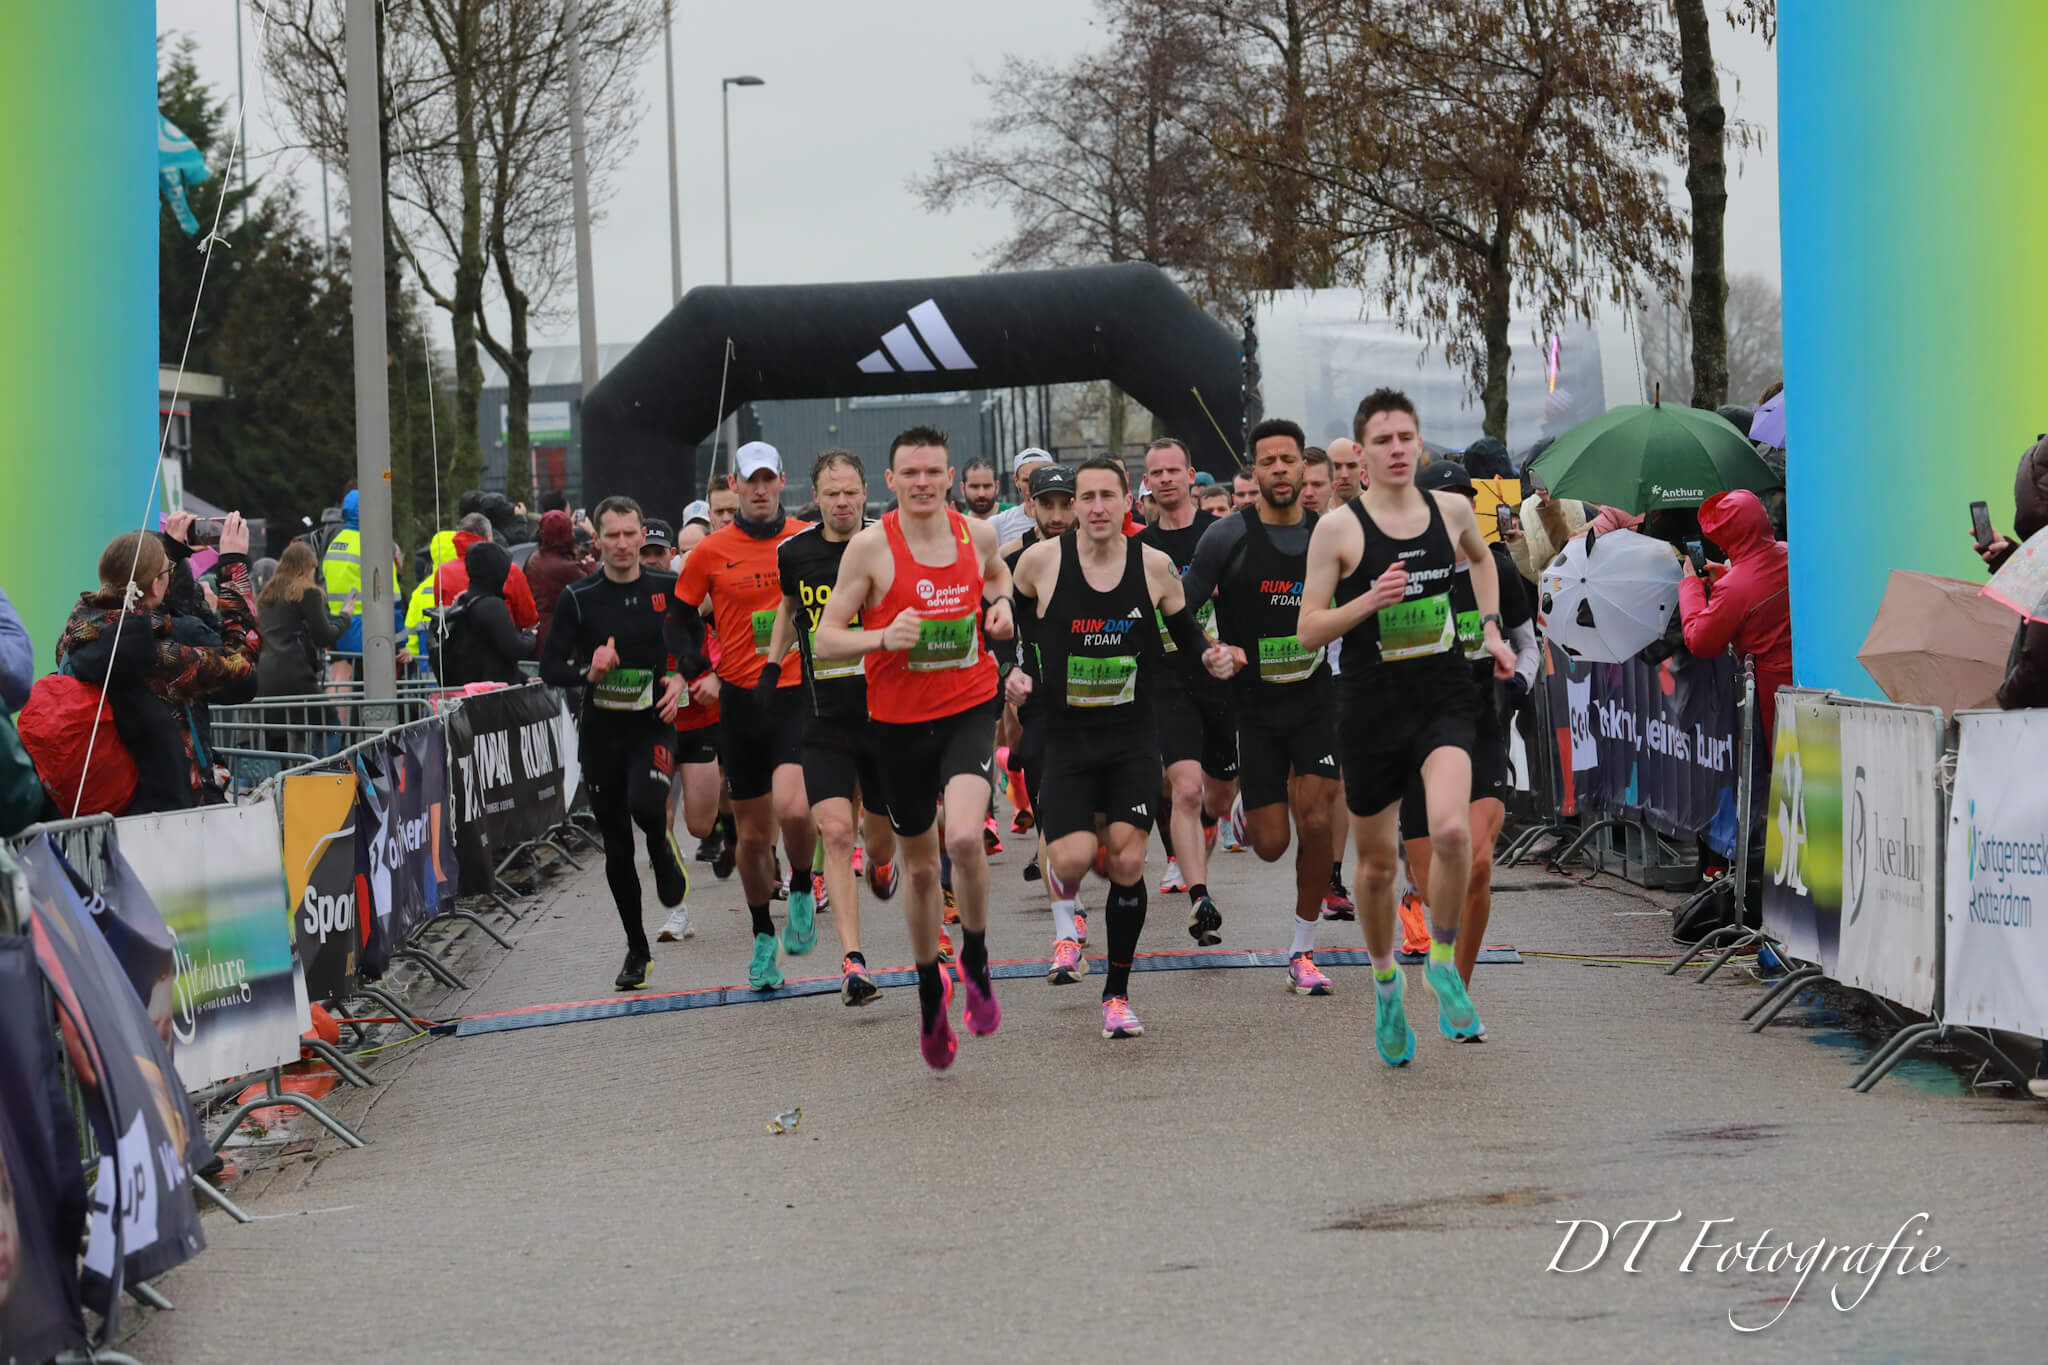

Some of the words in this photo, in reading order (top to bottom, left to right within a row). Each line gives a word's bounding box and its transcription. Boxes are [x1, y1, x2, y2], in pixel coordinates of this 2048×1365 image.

[1662, 488, 1704, 498] Anthura
[1407, 564, 1453, 583] unners'
[1404, 583, 1424, 596] ab
[927, 641, 957, 650] EMIEL
[1084, 634, 1122, 646] R'DAM
[597, 683, 642, 694] ALEXANDER
